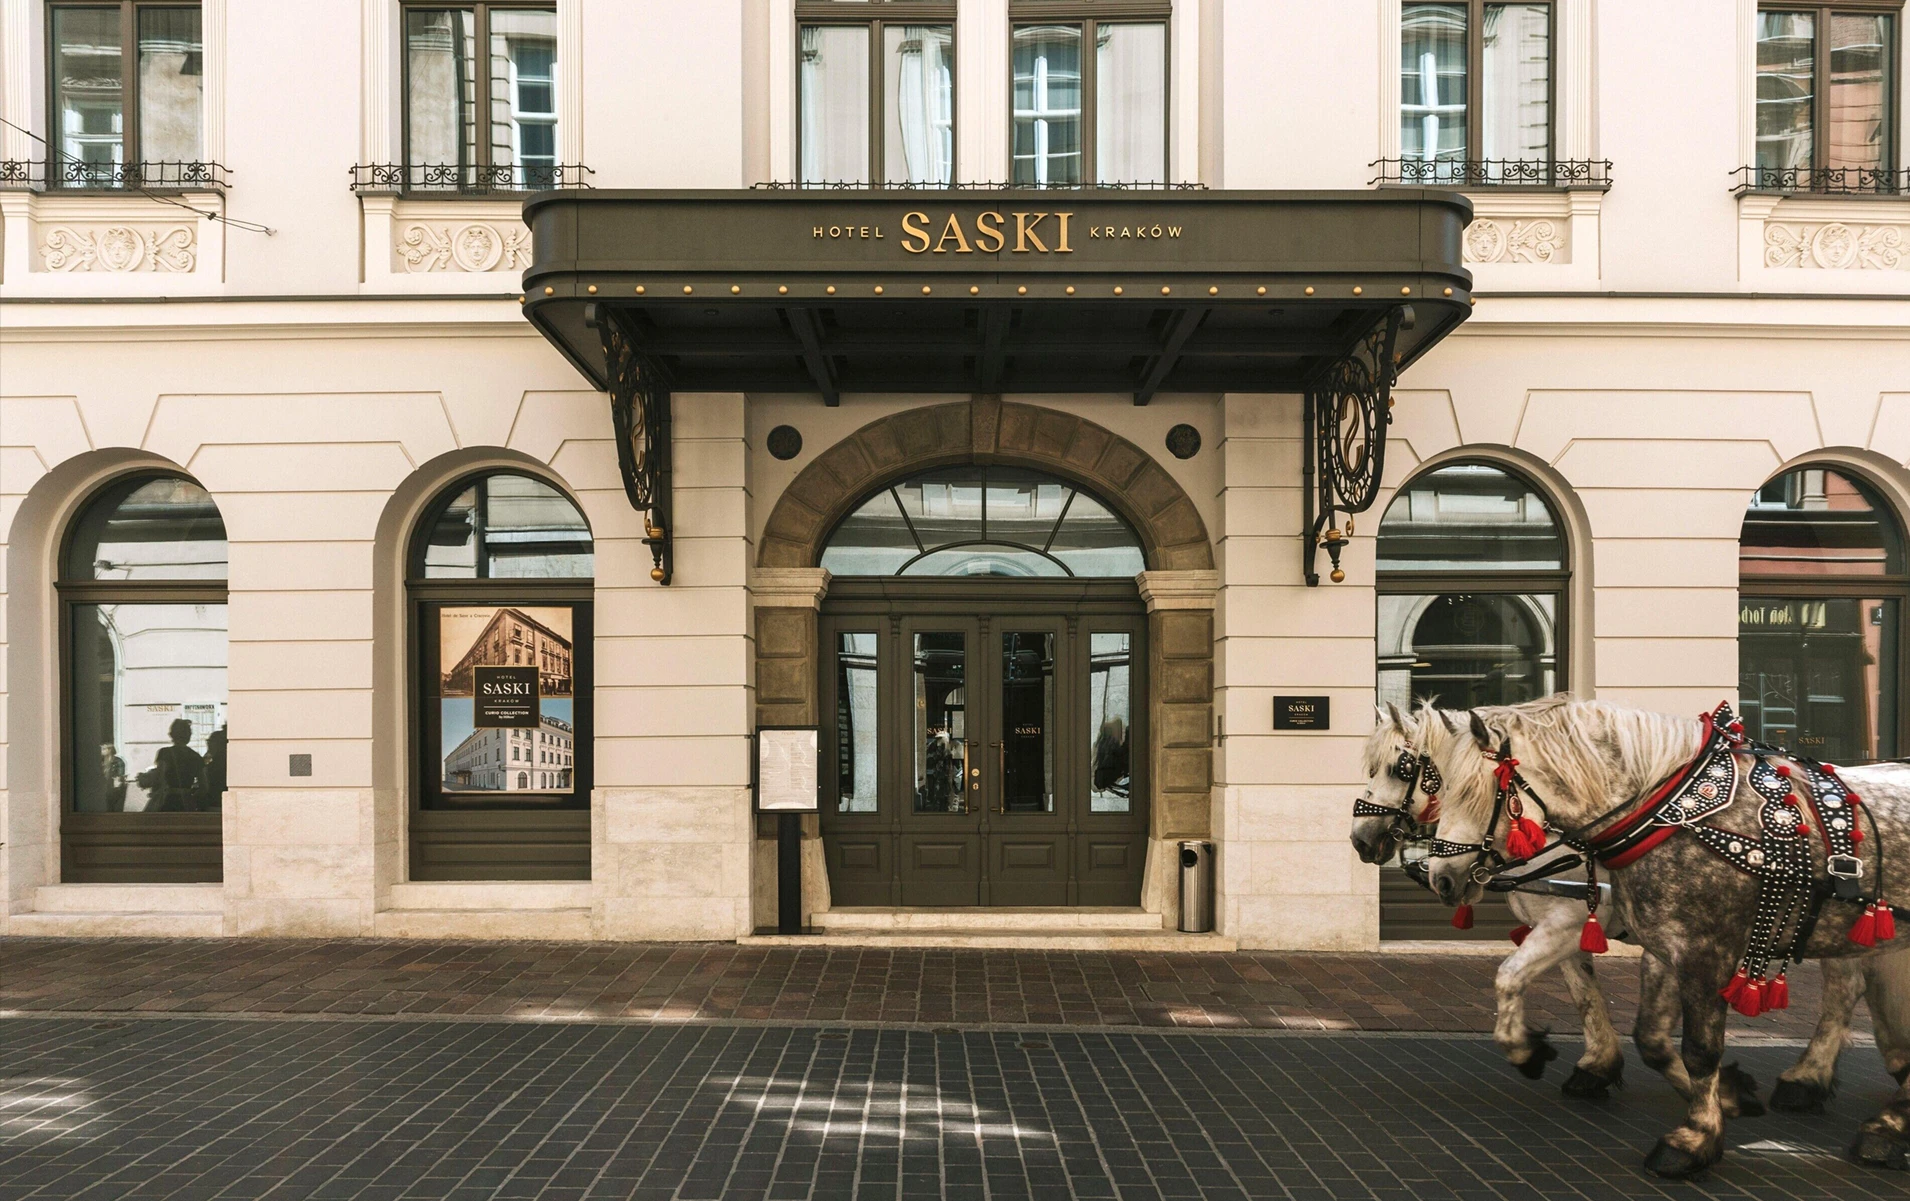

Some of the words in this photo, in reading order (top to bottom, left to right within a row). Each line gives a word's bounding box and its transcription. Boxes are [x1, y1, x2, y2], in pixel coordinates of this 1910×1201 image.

[813, 226, 885, 239] HOTEL
[901, 211, 1074, 254] SASKI
[1090, 222, 1183, 239] KRAKÓW
[483, 682, 531, 695] SASKI
[1288, 704, 1314, 712] SASKI
[1015, 727, 1041, 735] SASKI
[1798, 736, 1825, 744] SASKI
